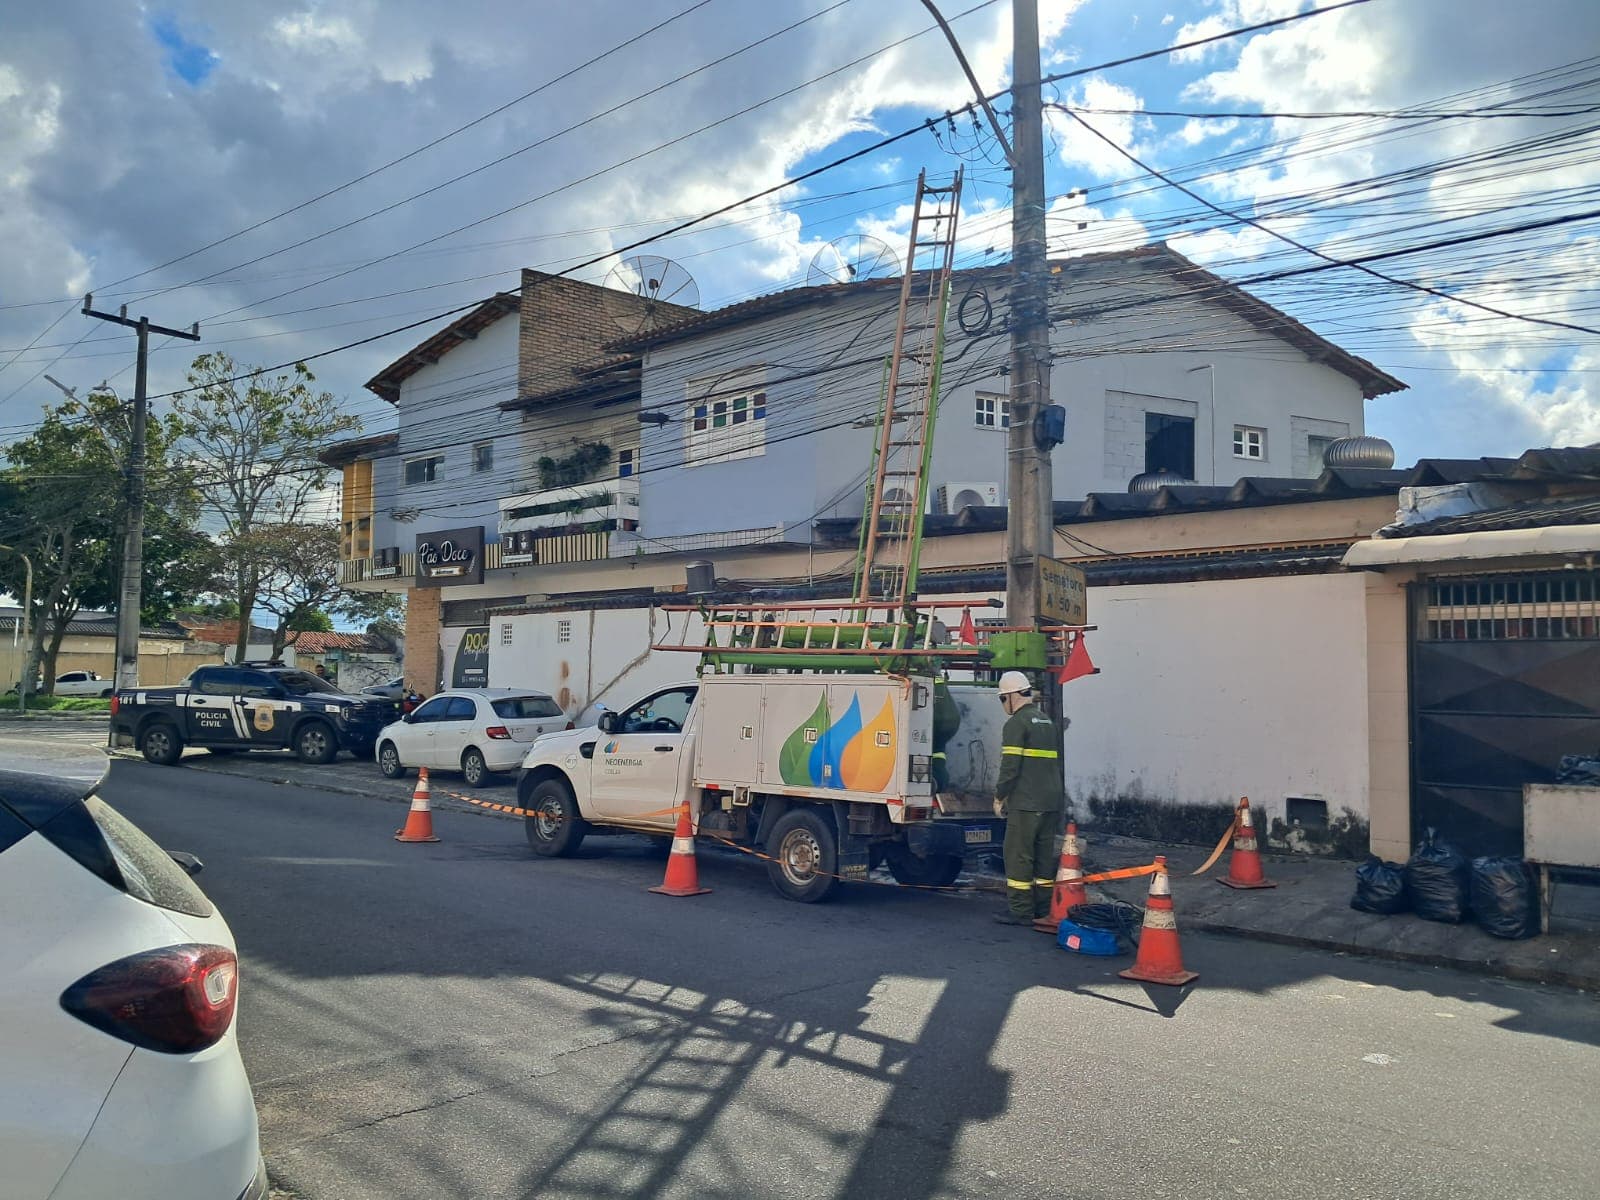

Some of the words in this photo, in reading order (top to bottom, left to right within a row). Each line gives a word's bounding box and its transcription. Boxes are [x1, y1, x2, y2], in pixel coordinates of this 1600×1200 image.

[419, 543, 438, 565] Pão
[1046, 593, 1053, 608] A
[1060, 597, 1070, 611] 50
[1073, 605, 1081, 617] m
[200, 720, 222, 728] CIVIL
[605, 759, 643, 767] NEOENERGIA
